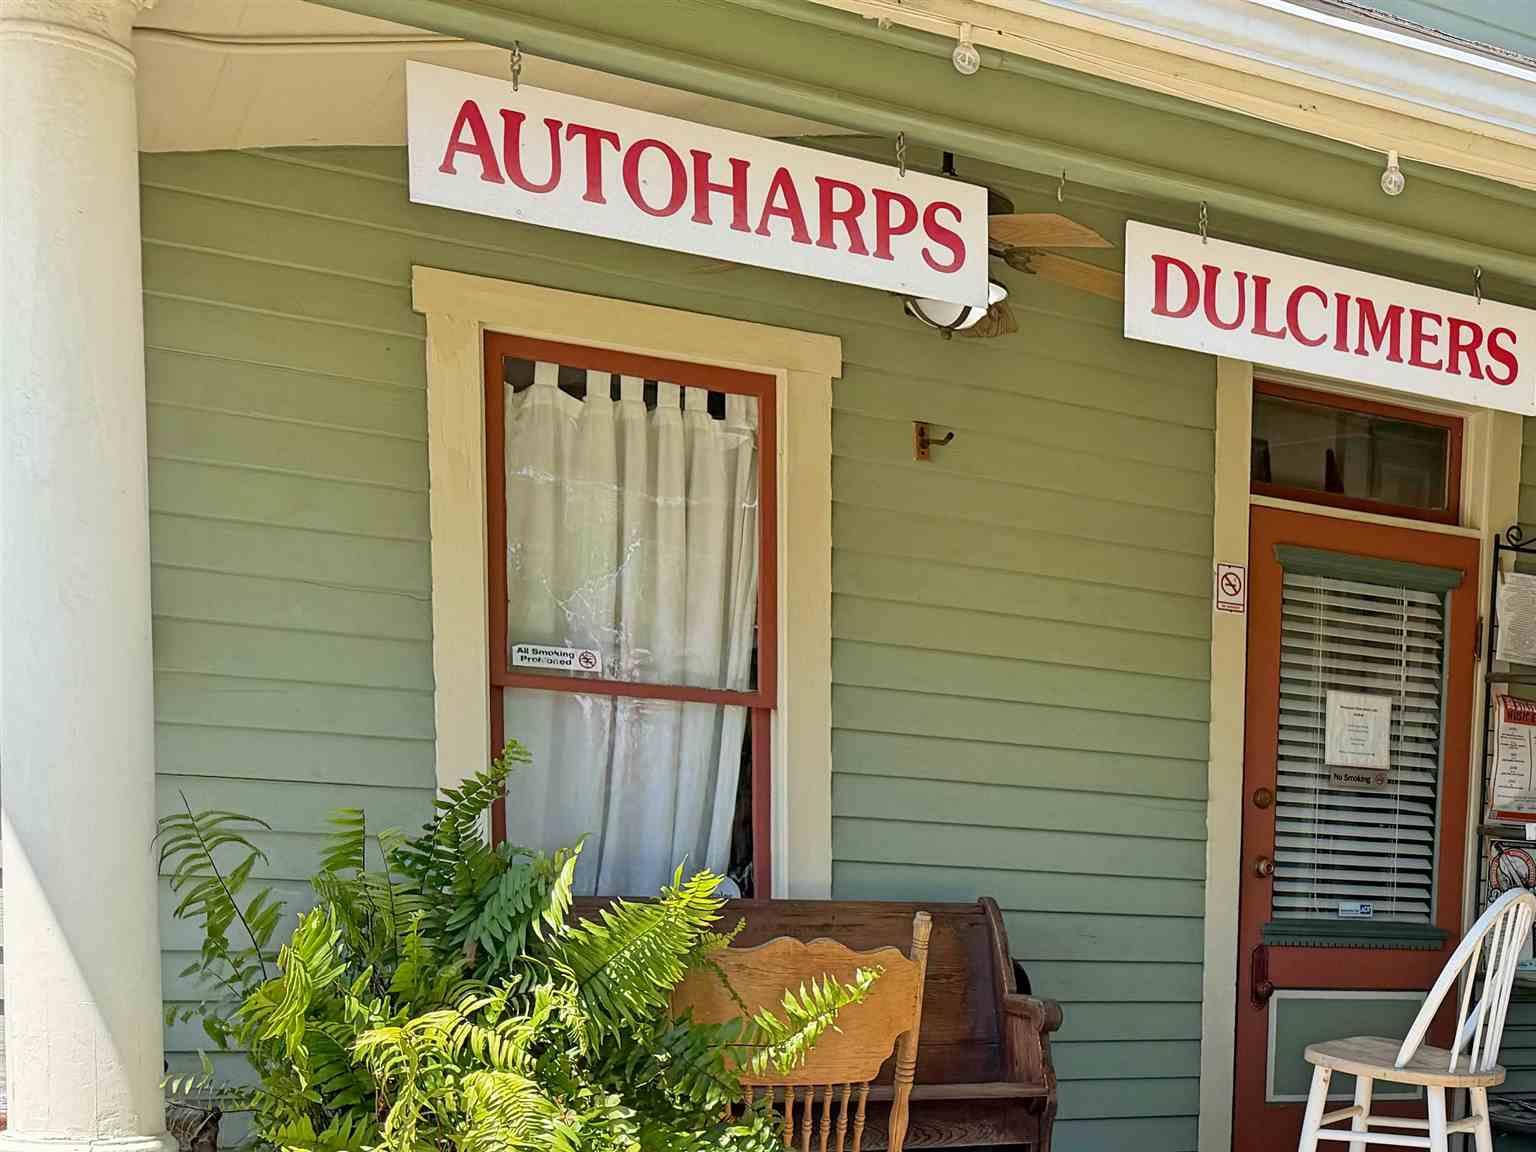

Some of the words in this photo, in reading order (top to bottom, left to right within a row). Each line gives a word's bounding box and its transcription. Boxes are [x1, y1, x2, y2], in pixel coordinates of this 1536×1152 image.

[438, 99, 967, 274] AUTOHARPS
[1151, 254, 1519, 386] DULCIMERS
[516, 647, 529, 655] All
[532, 648, 575, 660] Smoking
[1344, 773, 1371, 784] Smoking
